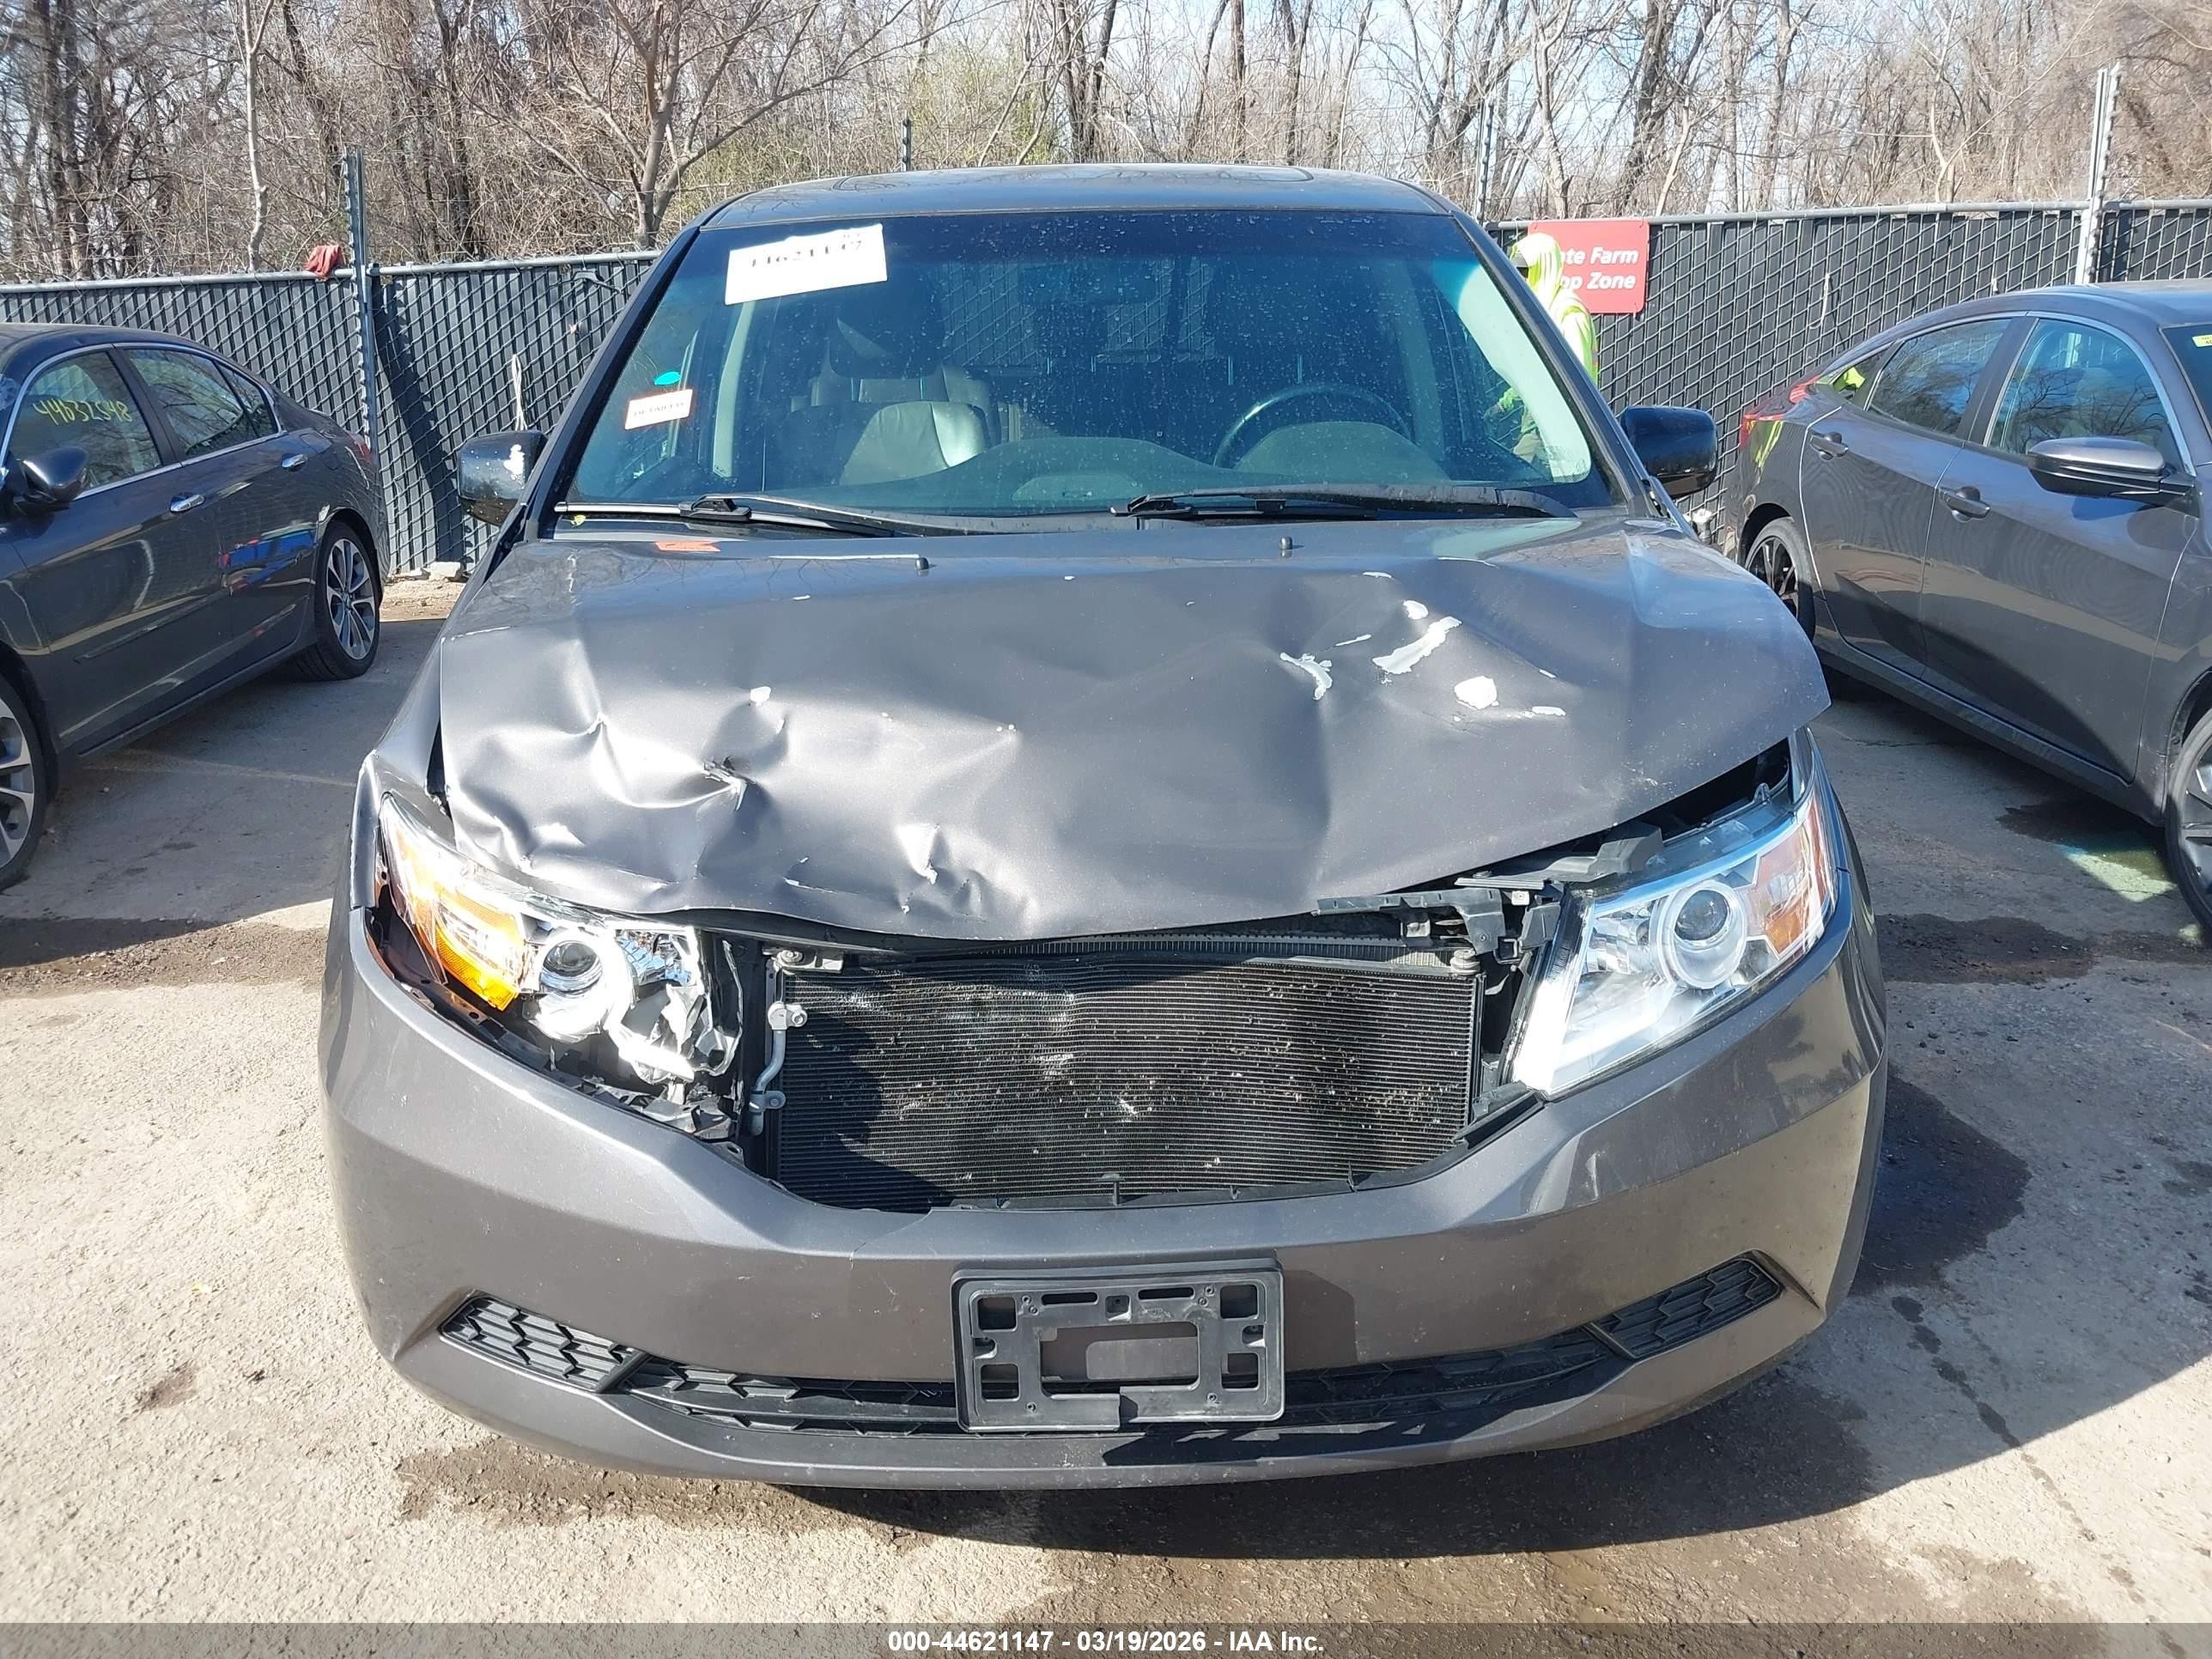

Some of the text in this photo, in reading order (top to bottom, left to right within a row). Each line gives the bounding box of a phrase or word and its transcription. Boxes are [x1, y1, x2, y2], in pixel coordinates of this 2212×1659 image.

[1589, 246, 1639, 265] Farm
[1561, 271, 1637, 289] op Zone
